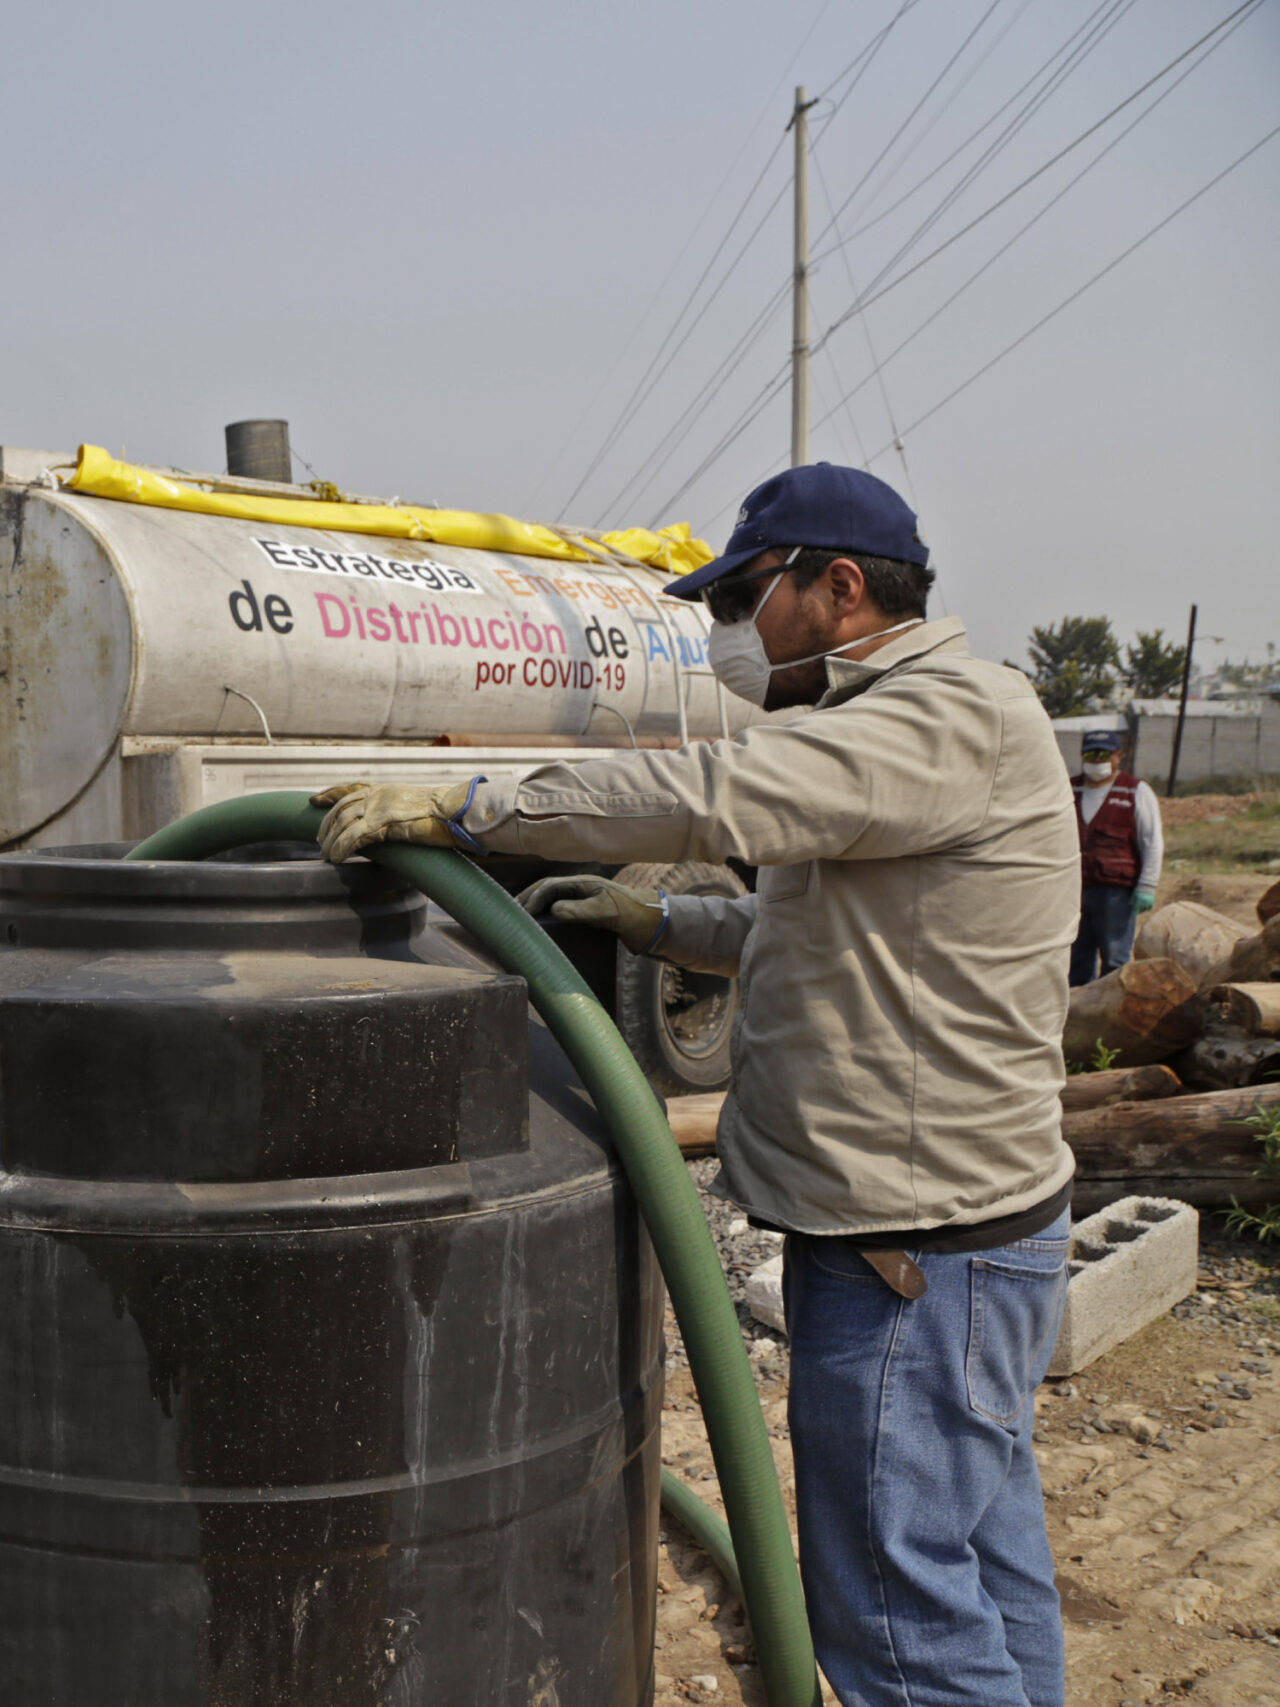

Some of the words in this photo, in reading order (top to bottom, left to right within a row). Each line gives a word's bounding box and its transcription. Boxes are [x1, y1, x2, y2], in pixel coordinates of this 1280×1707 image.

[257, 539, 477, 591] Estrategia
[494, 568, 679, 613] Emergen
[228, 579, 295, 635] de
[313, 591, 567, 655] Distribución
[584, 614, 630, 660] de
[475, 660, 517, 691] por
[523, 657, 626, 692] COVID-19
